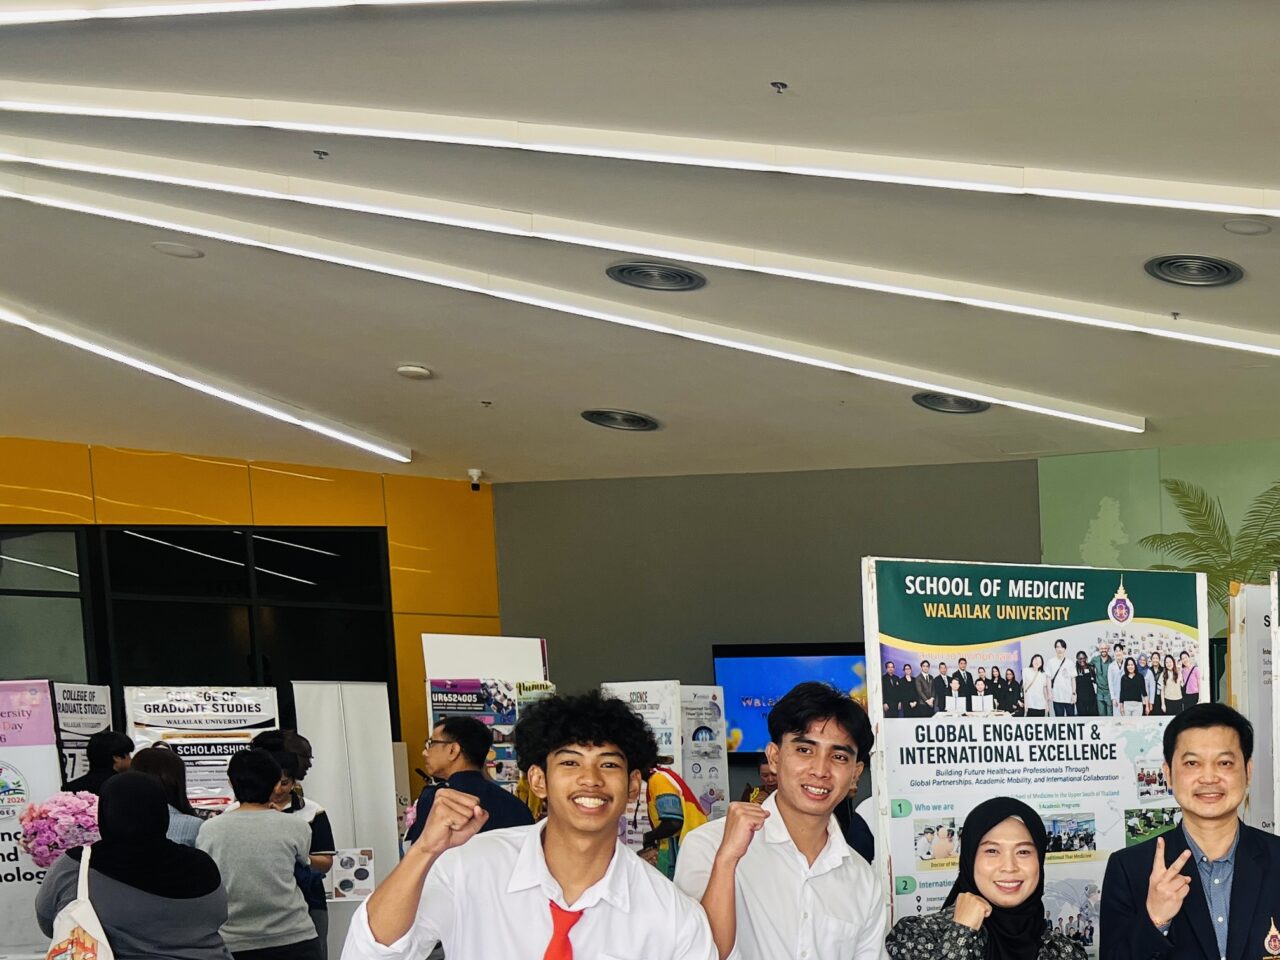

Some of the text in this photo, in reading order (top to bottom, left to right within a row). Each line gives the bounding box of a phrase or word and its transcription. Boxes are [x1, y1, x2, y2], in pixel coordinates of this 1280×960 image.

[905, 575, 1085, 600] SCHOOL OF MEDICINE
[923, 602, 1070, 621] WALAILAK UNIVERSITY
[62, 689, 96, 702] COLLEGE OF
[432, 693, 478, 703] UR6524005
[84, 704, 107, 714] STUDIES
[211, 703, 261, 713] STUDIES
[915, 723, 1101, 743] GLOBAL ENGAGEMENT &
[900, 743, 1117, 764] INTERNATIONAL EXCELLENCE
[987, 767, 1021, 775] Healthcare
[1023, 766, 1063, 774] Professionals
[898, 803, 903, 814] 1
[915, 803, 931, 811] Who
[902, 880, 908, 891] 2
